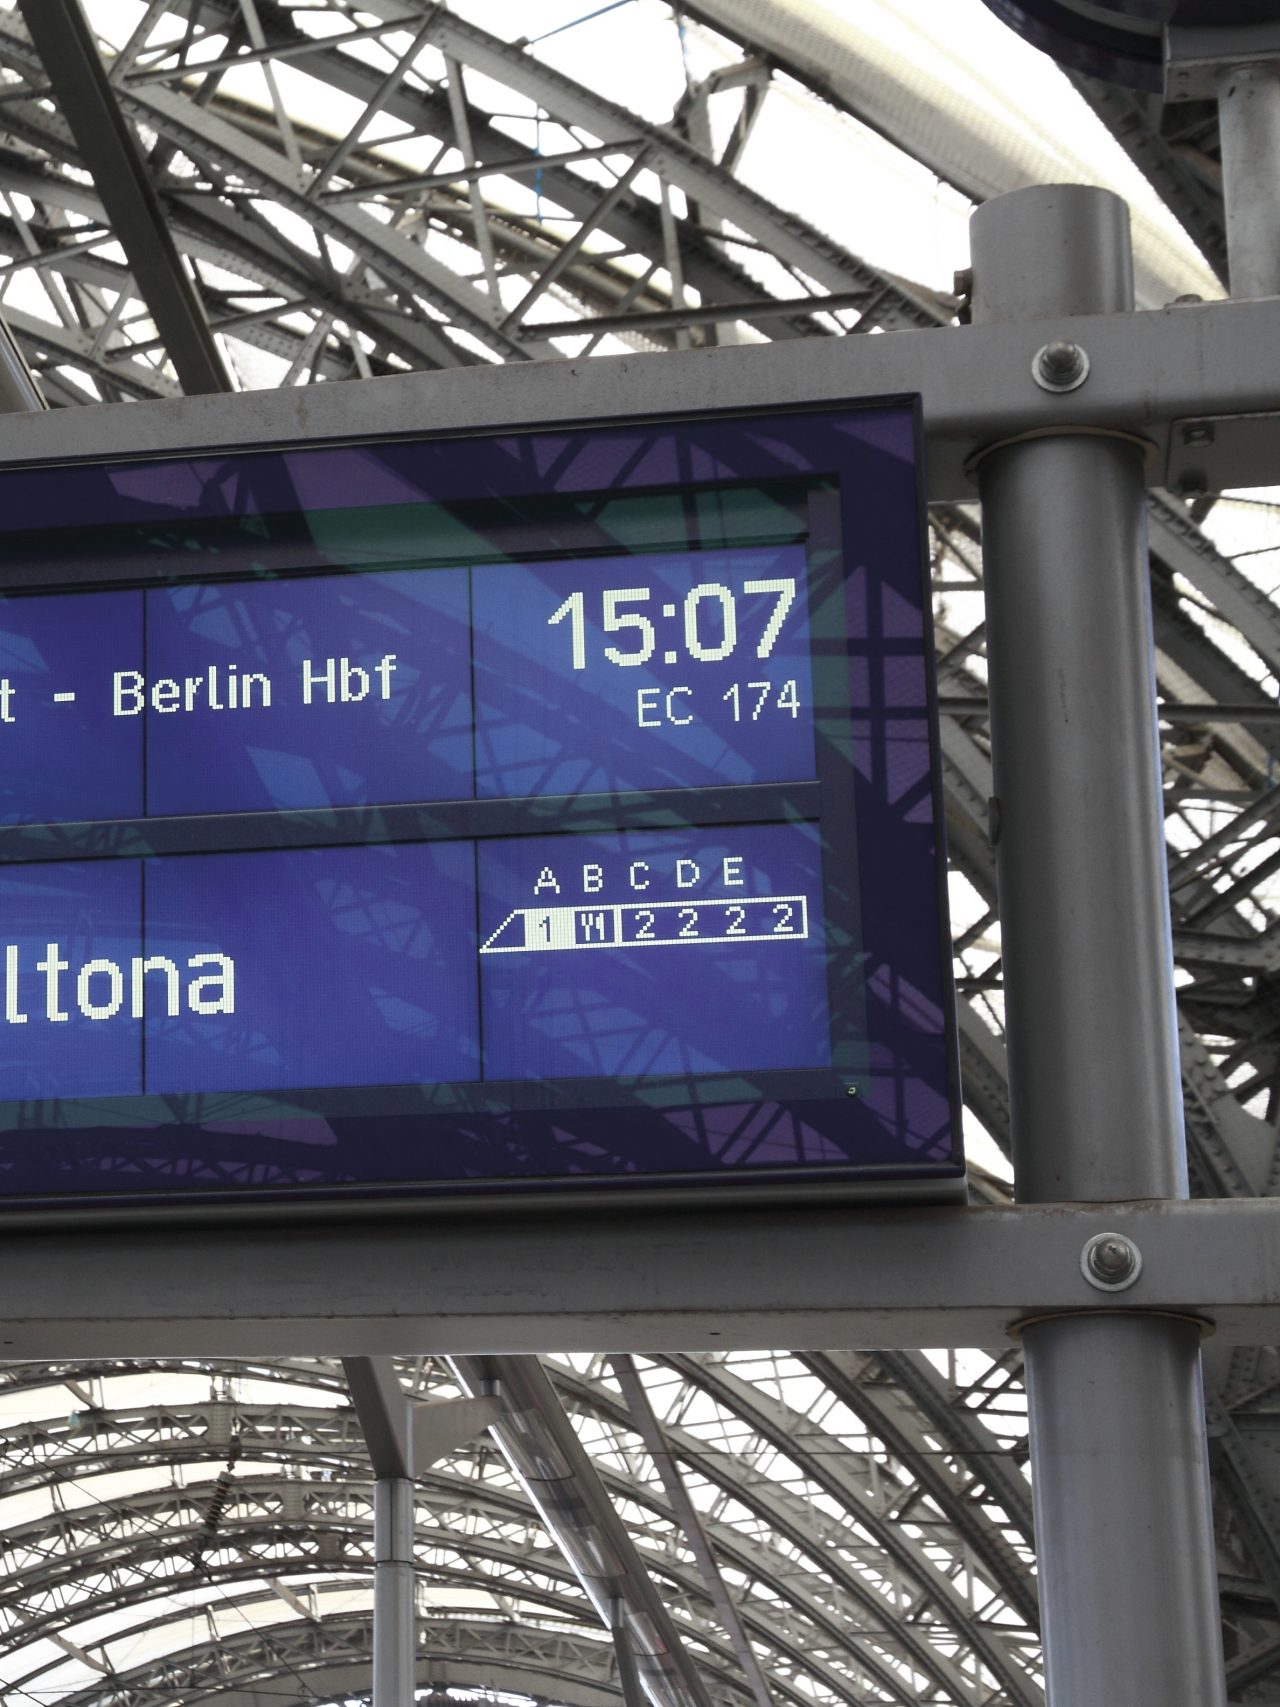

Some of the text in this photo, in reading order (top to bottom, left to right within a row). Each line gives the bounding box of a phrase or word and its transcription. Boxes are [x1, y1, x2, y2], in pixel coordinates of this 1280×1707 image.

[547, 577, 796, 670] 15:07
[113, 664, 271, 716] Berlin
[302, 654, 397, 705] Hbf
[637, 679, 801, 728] EC 174
[533, 856, 744, 895] A B C D E
[538, 903, 794, 944] 1 2 2 2 2
